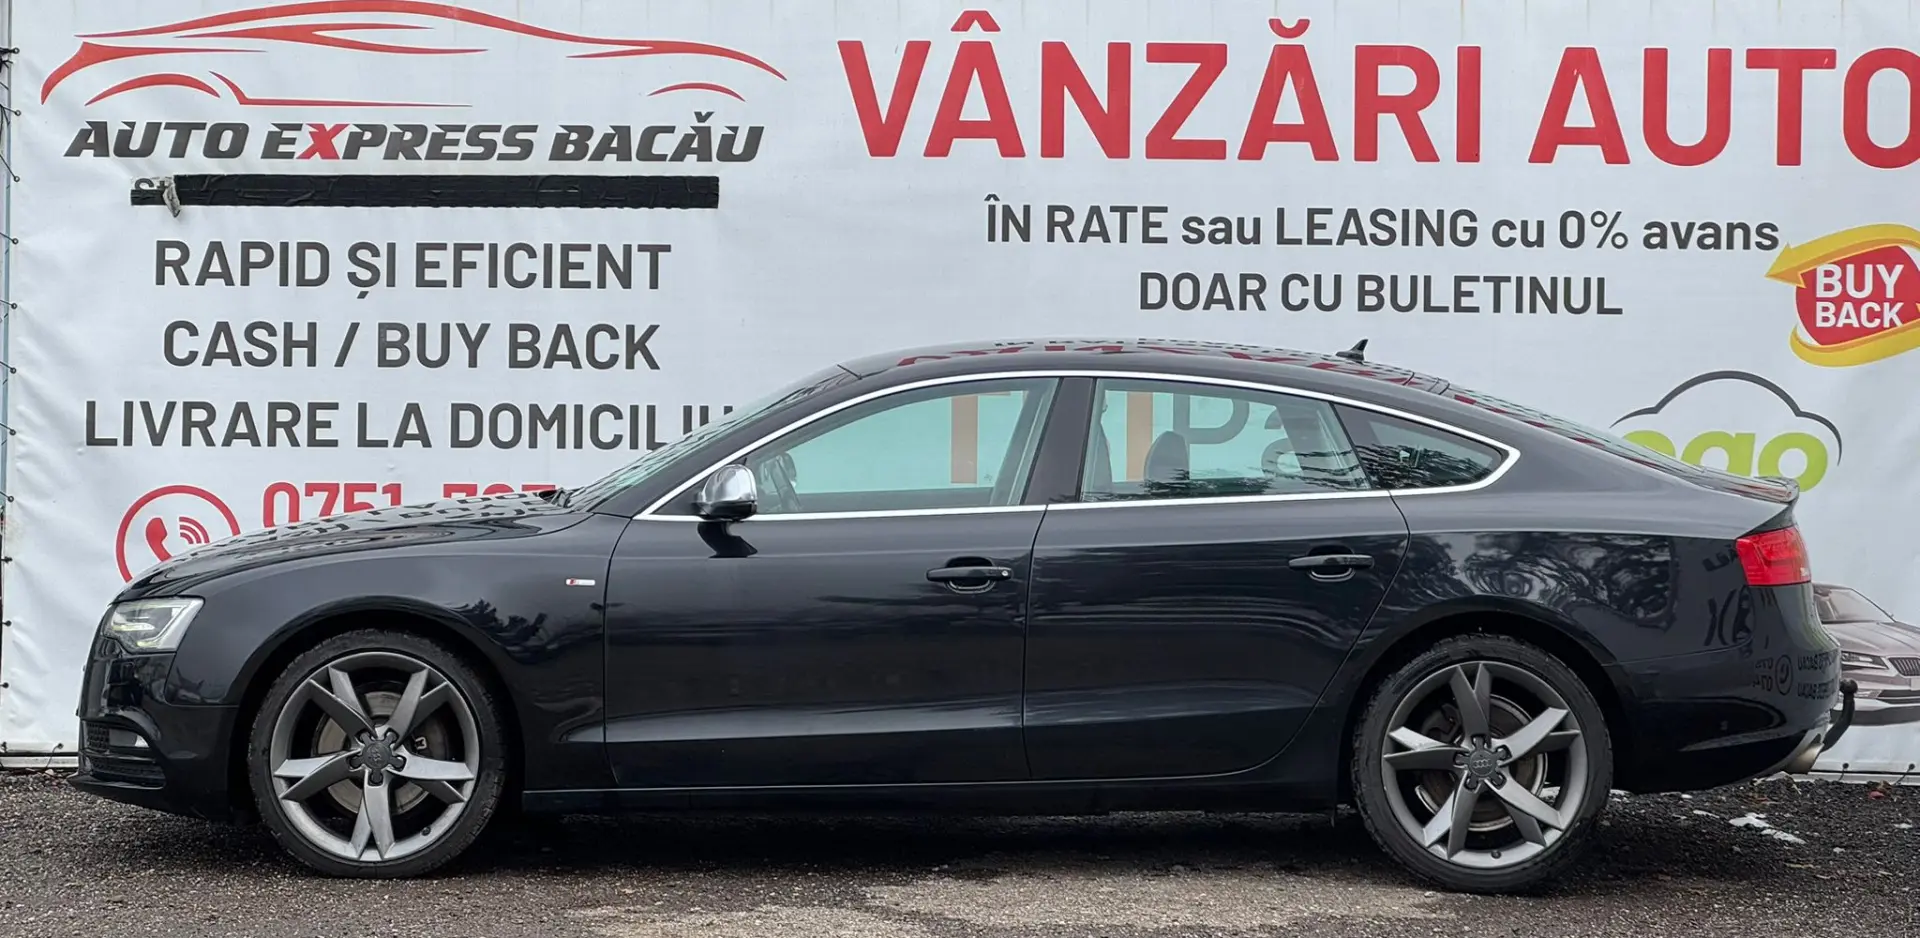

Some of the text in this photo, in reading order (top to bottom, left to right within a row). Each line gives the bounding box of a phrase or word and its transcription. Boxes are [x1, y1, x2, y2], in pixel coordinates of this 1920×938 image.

[839, 10, 1920, 169] VÂNZĂRI AUTO
[63, 111, 765, 163] AUTO EXPRESS BACĂU
[985, 194, 1779, 251] ÎN RATE sau LEASING cu 0% avans
[155, 240, 672, 300] RAPID ȘI EFICIENT
[1140, 272, 1623, 315] DOAR CU BULETINUL
[1815, 263, 1904, 299] BUY
[1815, 301, 1904, 328] BACK
[163, 320, 661, 371] CASH / BUY BACK
[85, 400, 340, 449] LIVRARE
[357, 402, 432, 449] LA
